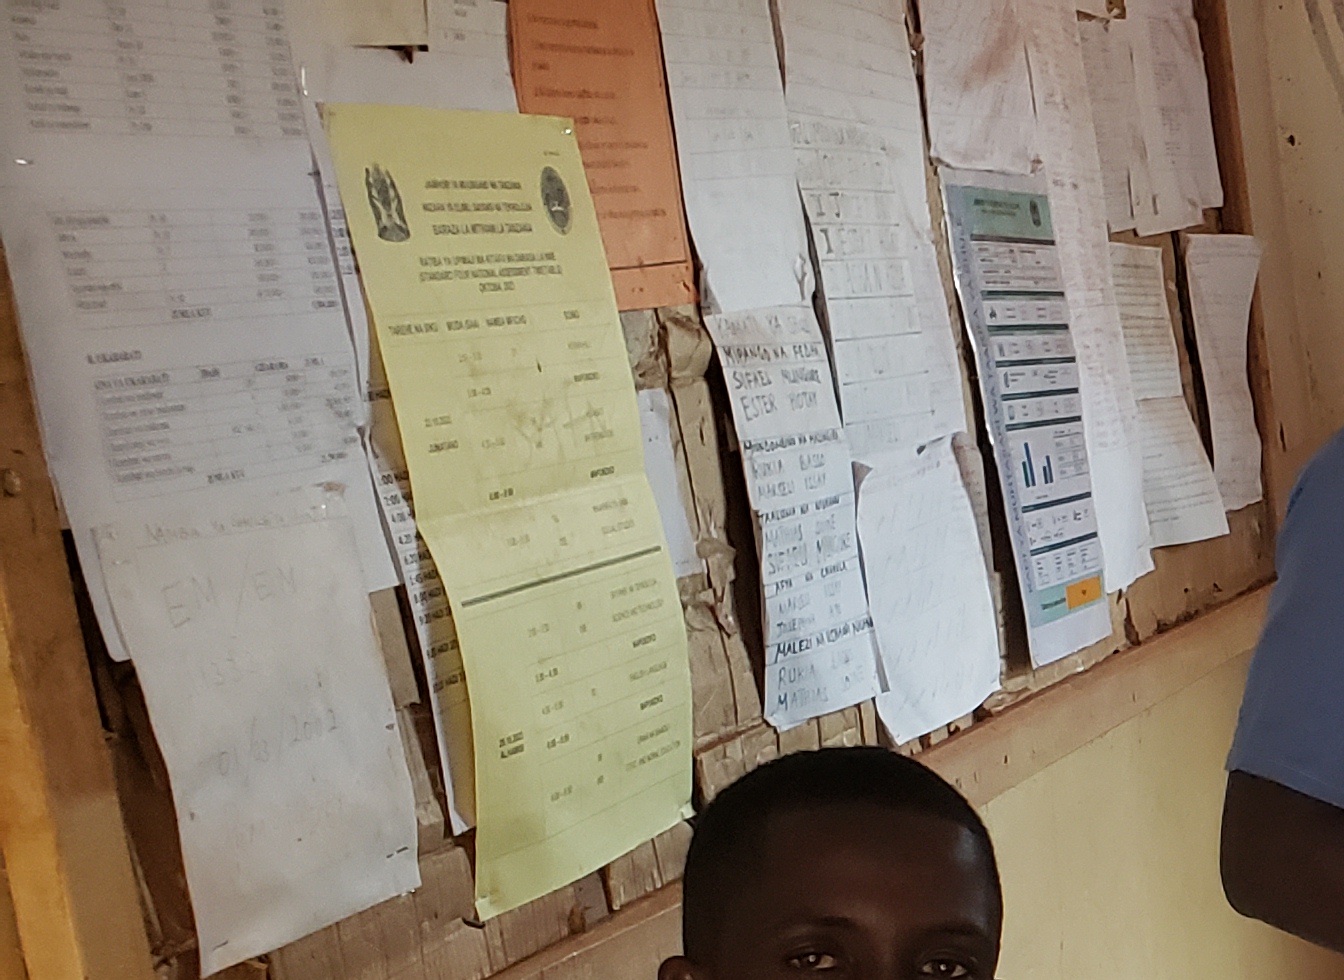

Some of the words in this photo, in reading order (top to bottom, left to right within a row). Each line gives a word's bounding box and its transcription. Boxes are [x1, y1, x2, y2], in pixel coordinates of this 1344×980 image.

[740, 393, 778, 422] ESTER
[775, 637, 813, 664] MALEZI
[778, 664, 815, 689] RUKIA
